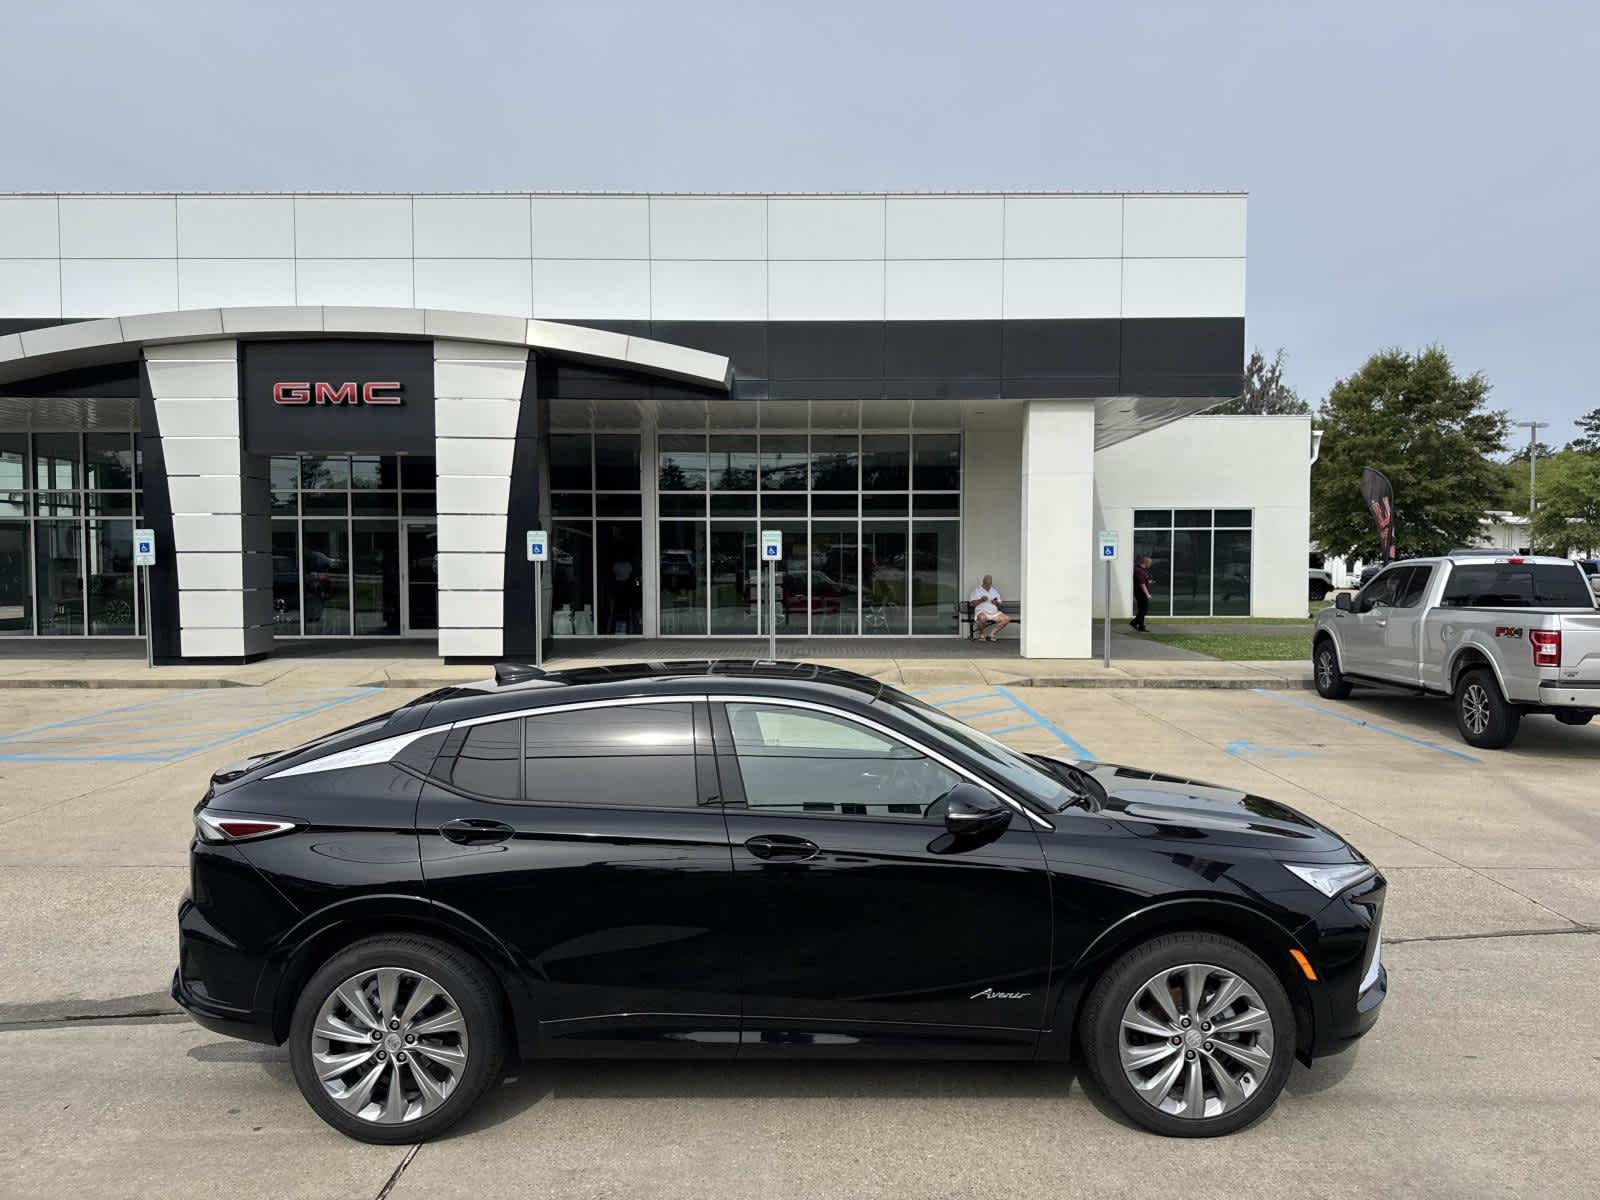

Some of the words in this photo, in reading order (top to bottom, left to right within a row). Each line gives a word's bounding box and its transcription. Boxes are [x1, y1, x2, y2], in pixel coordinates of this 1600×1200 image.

[273, 382, 401, 404] GMC
[1495, 626, 1523, 639] FX4
[970, 988, 1031, 999] Avenir
